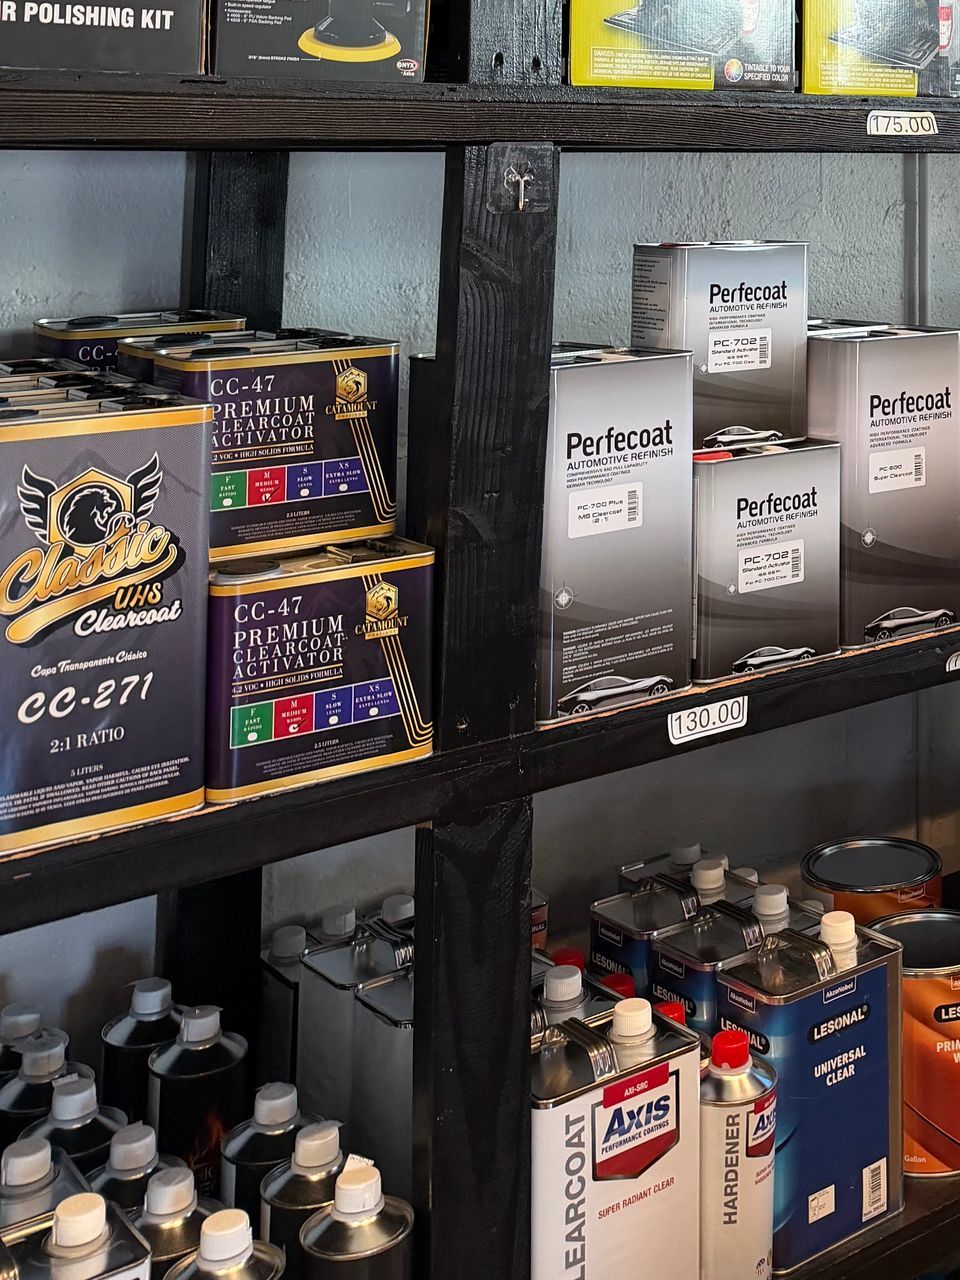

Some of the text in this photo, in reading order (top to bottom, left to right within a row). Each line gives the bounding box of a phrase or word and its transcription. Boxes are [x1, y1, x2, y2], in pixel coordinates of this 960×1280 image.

[28, 2, 174, 31] POLISHING KIT
[869, 114, 931, 135] 175.00
[709, 280, 788, 305] Perfecoat
[709, 301, 788, 313] AUTOMOTIVE REFINISH
[869, 386, 952, 418] Perfecoat
[566, 419, 673, 460] Perfecoat
[566, 447, 674, 471] AUTOMOTIVE REFINISH
[736, 486, 818, 520] Perfecoat
[0, 520, 171, 615] Classic
[113, 581, 163, 611] UHS
[234, 595, 303, 624] CC-47
[74, 600, 183, 637] Clearcoat
[233, 614, 344, 650] PREMIUM
[354, 616, 409, 636] CATAMOUNT
[233, 632, 345, 665] CLEARCOAT
[233, 647, 344, 680] ACTIVATOR
[17, 671, 154, 726] CC-271
[673, 699, 742, 734] 130.00
[50, 726, 125, 754] 2:1 RATIO
[813, 1006, 865, 1041] LESONAL
[814, 1045, 866, 1079] UNIVERSAL
[825, 1063, 856, 1087] CLEAR
[602, 1094, 670, 1144] AXIS
[601, 1119, 670, 1155] PERFORMANCE COATINGS
[723, 1113, 740, 1225] HARDENER
[904, 1154, 927, 1164] Gallon
[597, 1176, 675, 1220] SUPER RADIANT CLEAR
